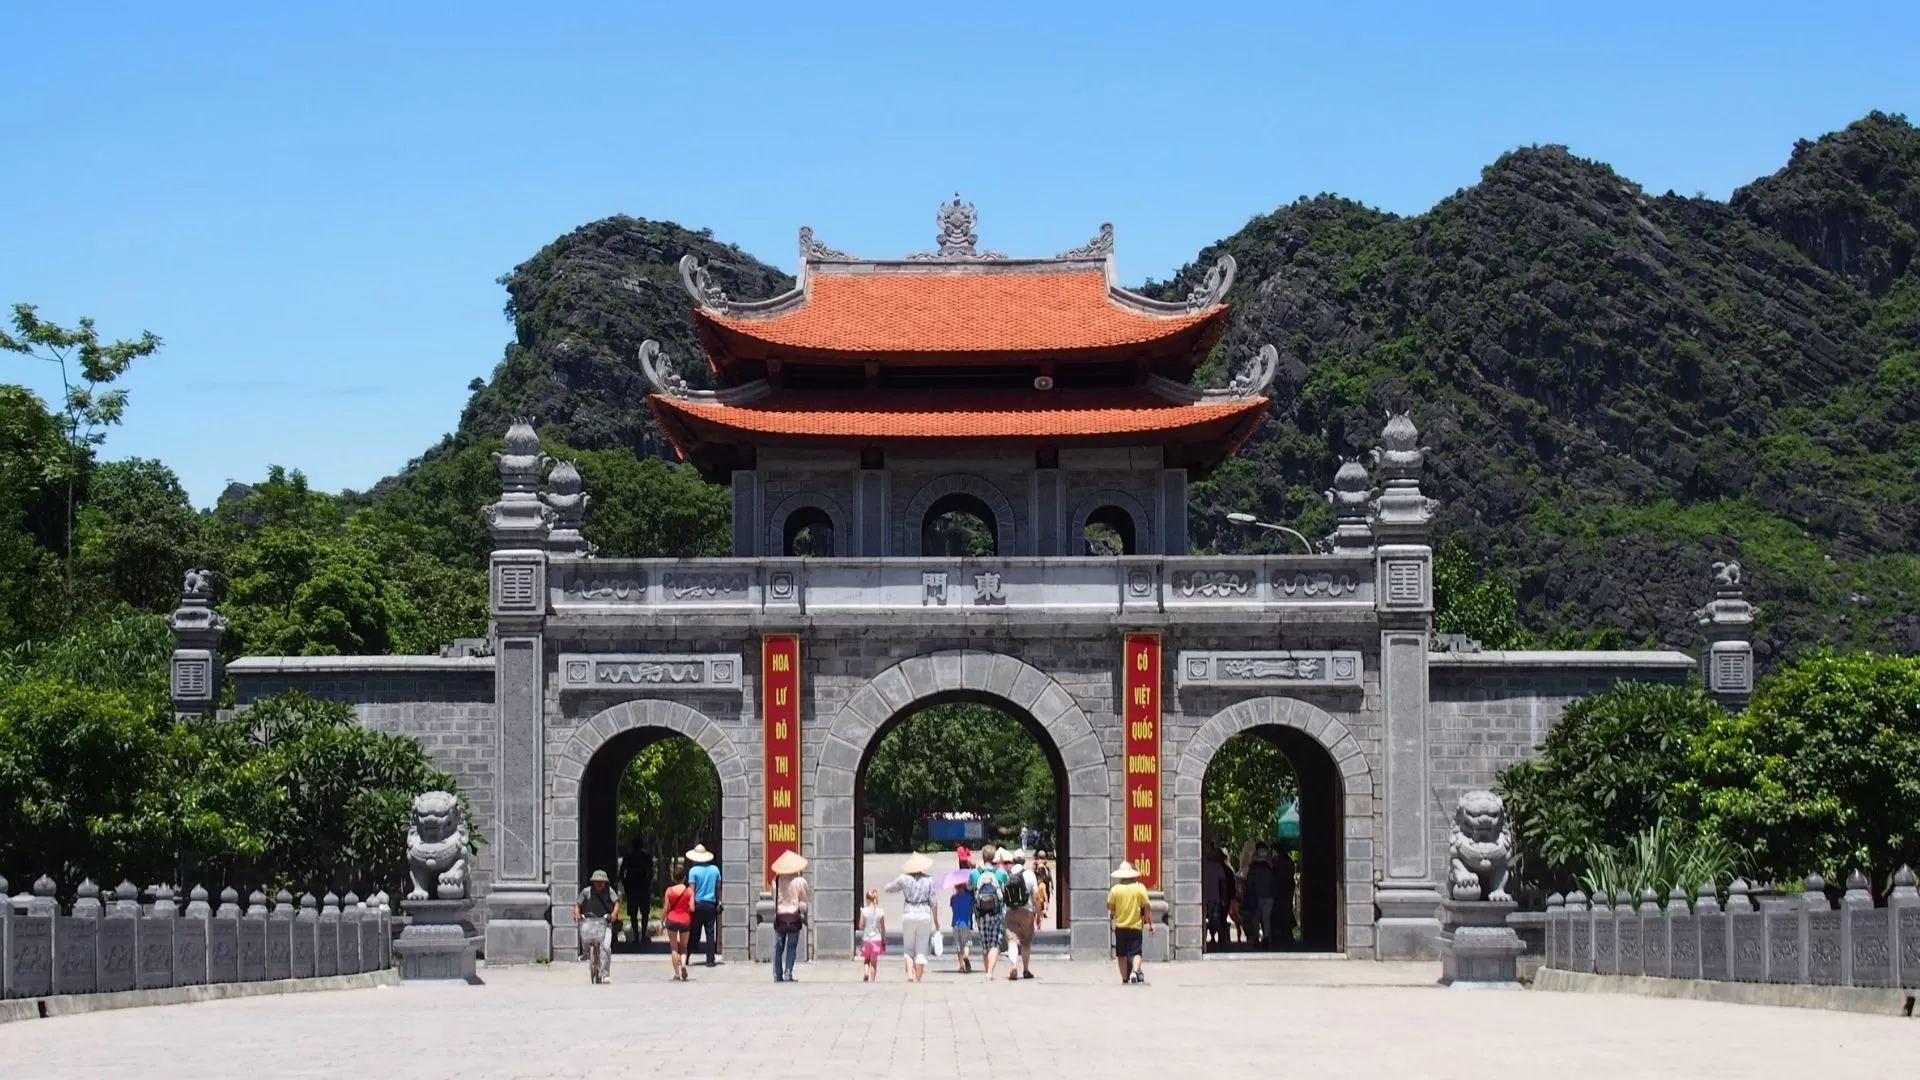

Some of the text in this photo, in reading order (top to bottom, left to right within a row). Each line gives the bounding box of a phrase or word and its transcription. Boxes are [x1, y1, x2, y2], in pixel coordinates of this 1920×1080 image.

[1133, 684, 1151, 709] VIỆT
[1132, 715, 1153, 741] QUỐC
[768, 653, 796, 842] HOA LƯ ĐÔ THỊ HÁN TRÀNG
[1129, 754, 1156, 774] ĐƯƠNG
[1132, 784, 1153, 808] TỐNG
[1133, 824, 1152, 842] KHAI
